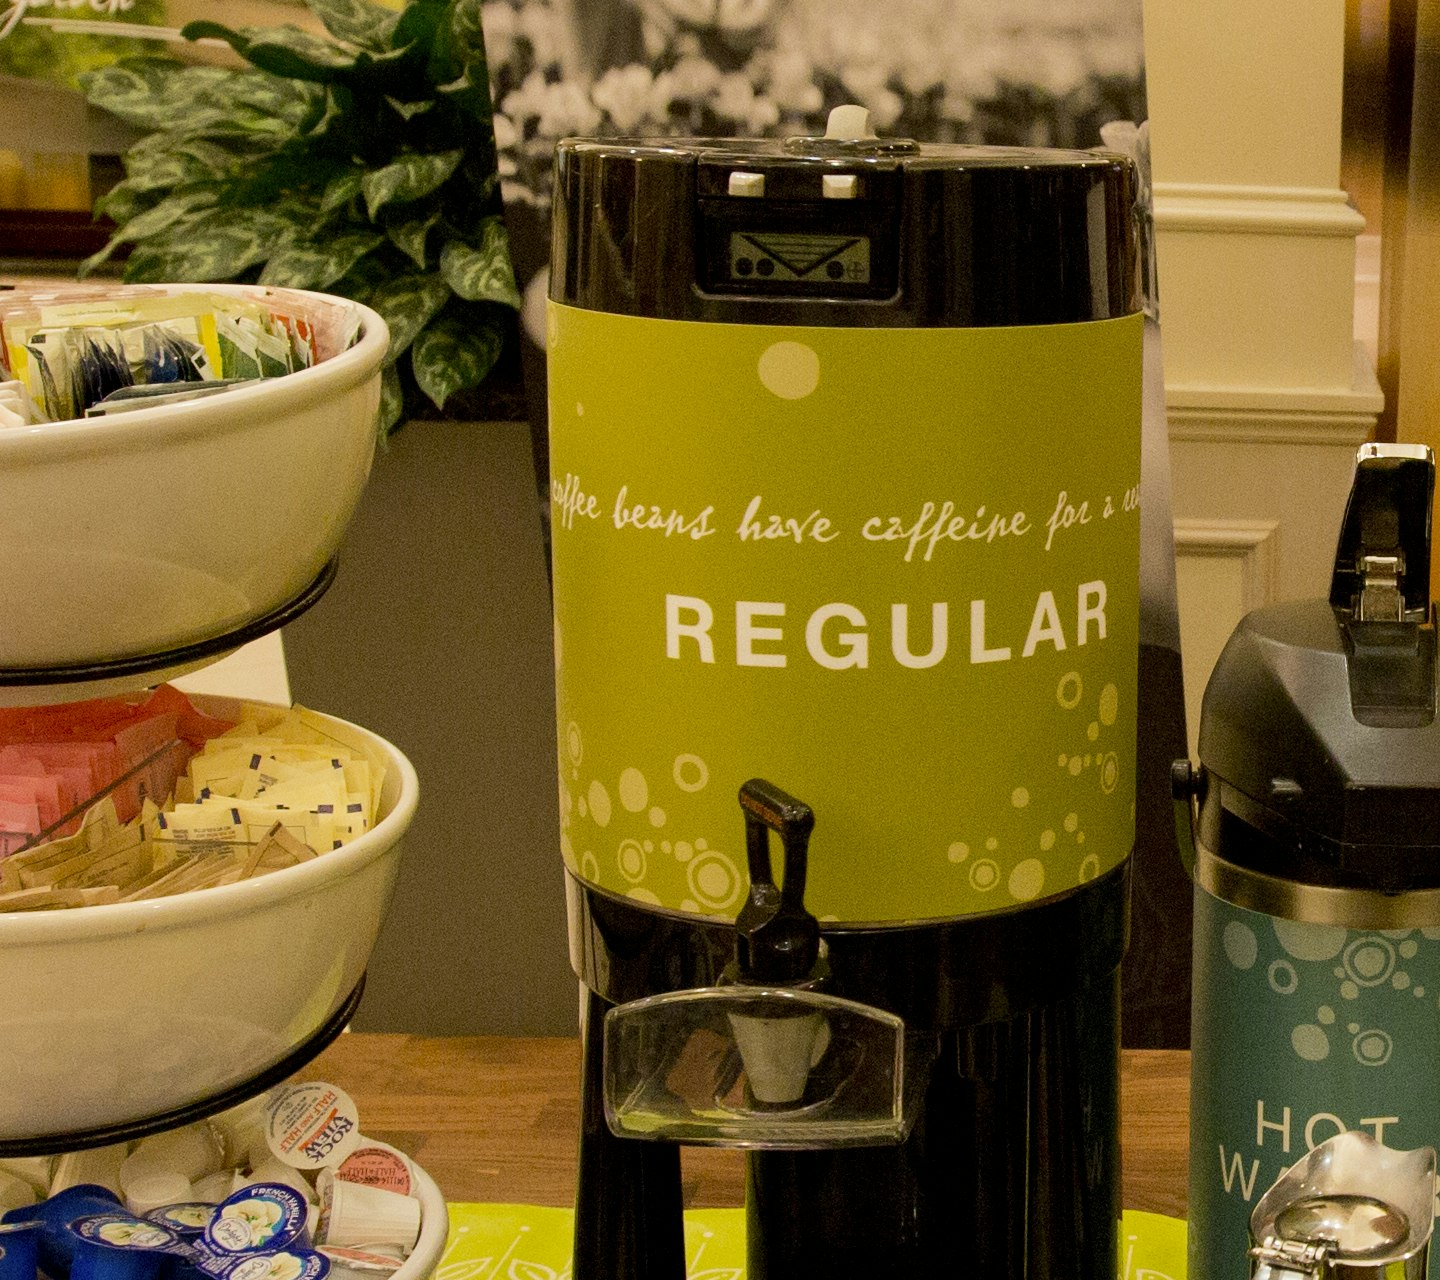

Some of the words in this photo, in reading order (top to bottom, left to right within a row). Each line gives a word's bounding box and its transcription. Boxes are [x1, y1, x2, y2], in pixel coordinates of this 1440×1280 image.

[612, 484, 716, 541] beans
[735, 495, 841, 544] have
[860, 500, 1033, 563] caffeine
[1044, 490, 1093, 552] for
[1102, 495, 1115, 520] a
[665, 579, 1108, 670] REGULAR
[313, 1089, 339, 1117] HALF
[1255, 1099, 1400, 1153] HOT
[280, 1127, 302, 1154] HALF
[303, 1114, 345, 1157] VIEW
[310, 1115, 354, 1163] ROCK
[250, 1186, 293, 1202] FRENCH
[283, 1196, 302, 1234] VANILLA
